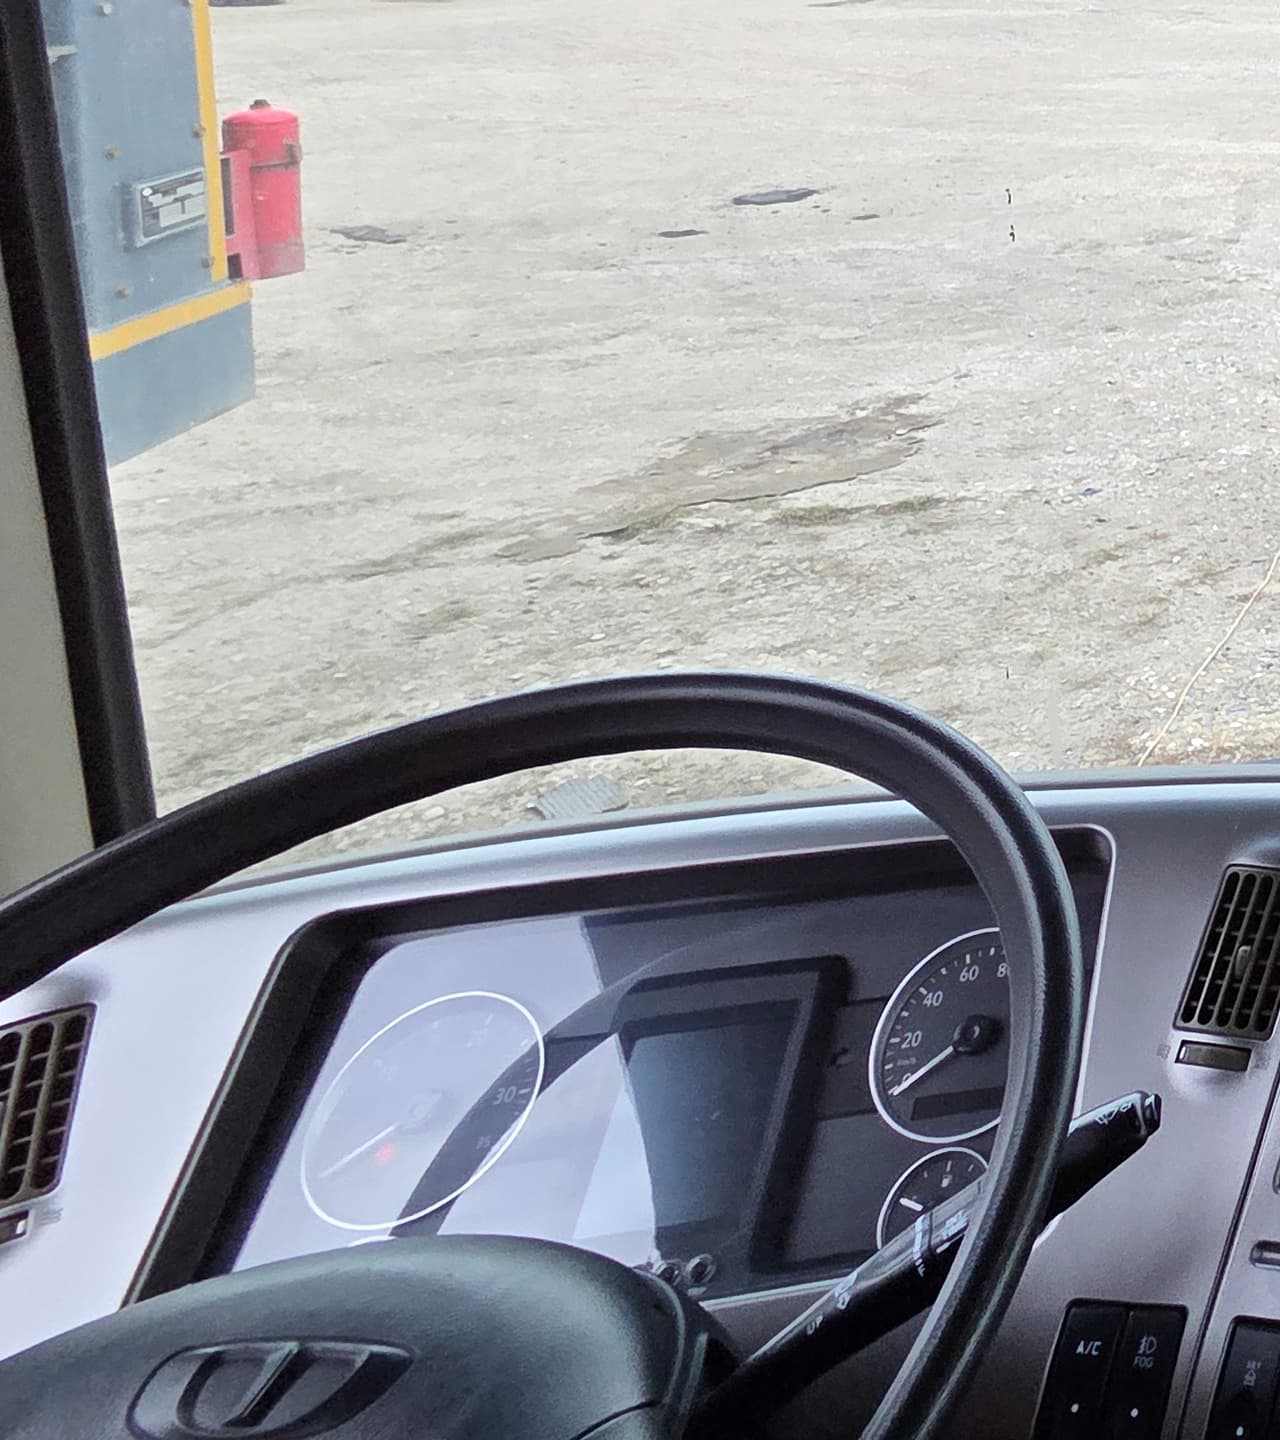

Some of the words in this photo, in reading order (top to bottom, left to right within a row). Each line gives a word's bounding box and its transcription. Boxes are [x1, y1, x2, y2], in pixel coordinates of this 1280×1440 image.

[959, 965, 979, 982] 60
[997, 962, 1010, 978] 8
[923, 990, 943, 1007] 40
[901, 1031, 922, 1048] 20
[493, 1086, 517, 1105] 30
[1075, 1340, 1102, 1356] A/C
[1132, 1356, 1154, 1368] FOG
